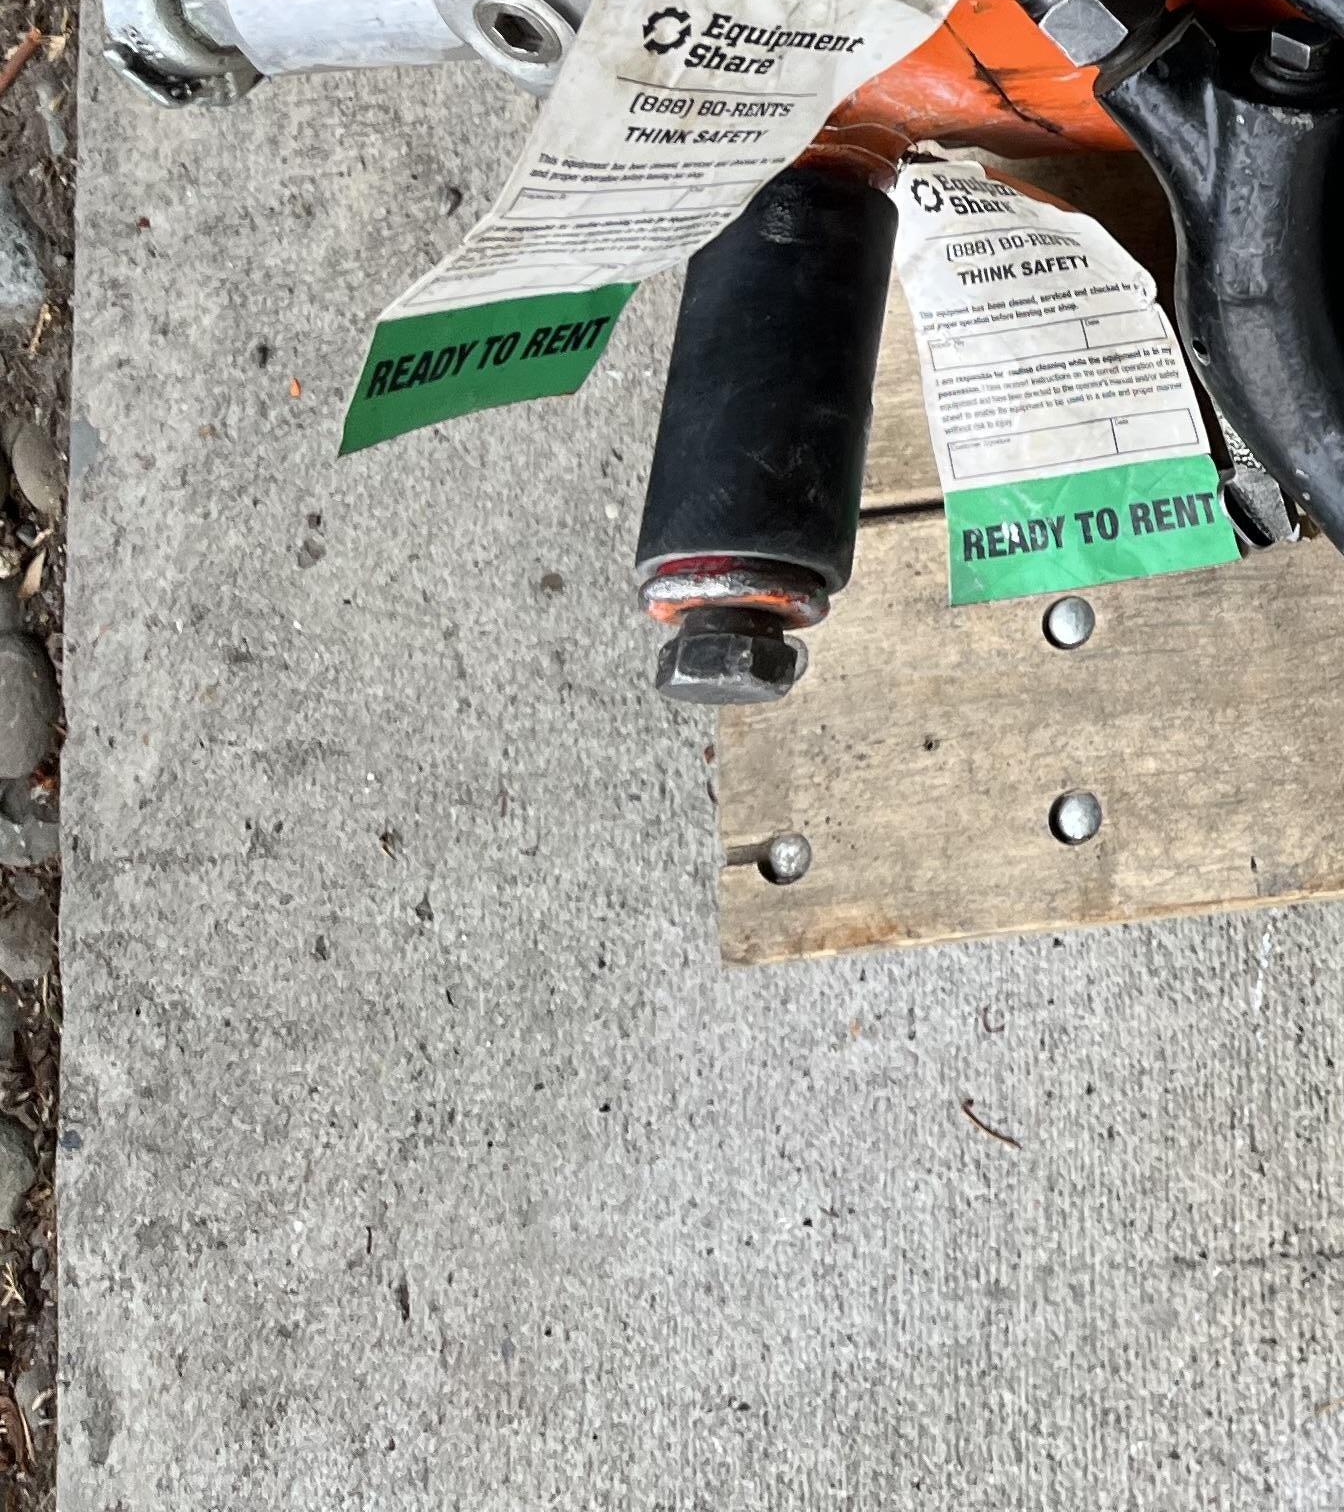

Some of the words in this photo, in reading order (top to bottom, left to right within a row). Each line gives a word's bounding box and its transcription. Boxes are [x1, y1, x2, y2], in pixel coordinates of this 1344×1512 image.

[701, 12, 866, 53] Equipment
[684, 43, 775, 75] Share
[629, 92, 695, 118] (888)
[698, 99, 796, 118] 80-RENTS
[624, 126, 691, 145] THINK
[693, 129, 769, 145] SAFETY
[946, 238, 996, 263] (888)
[957, 263, 1017, 287] THINK
[1020, 255, 1089, 277] SAFETY
[1089, 284, 1120, 295] checked
[364, 340, 481, 399] READY
[476, 331, 521, 370] TO
[519, 316, 611, 361] RENT
[962, 515, 1066, 562] READY
[1074, 507, 1120, 544] TO
[1128, 492, 1216, 536] RENT
